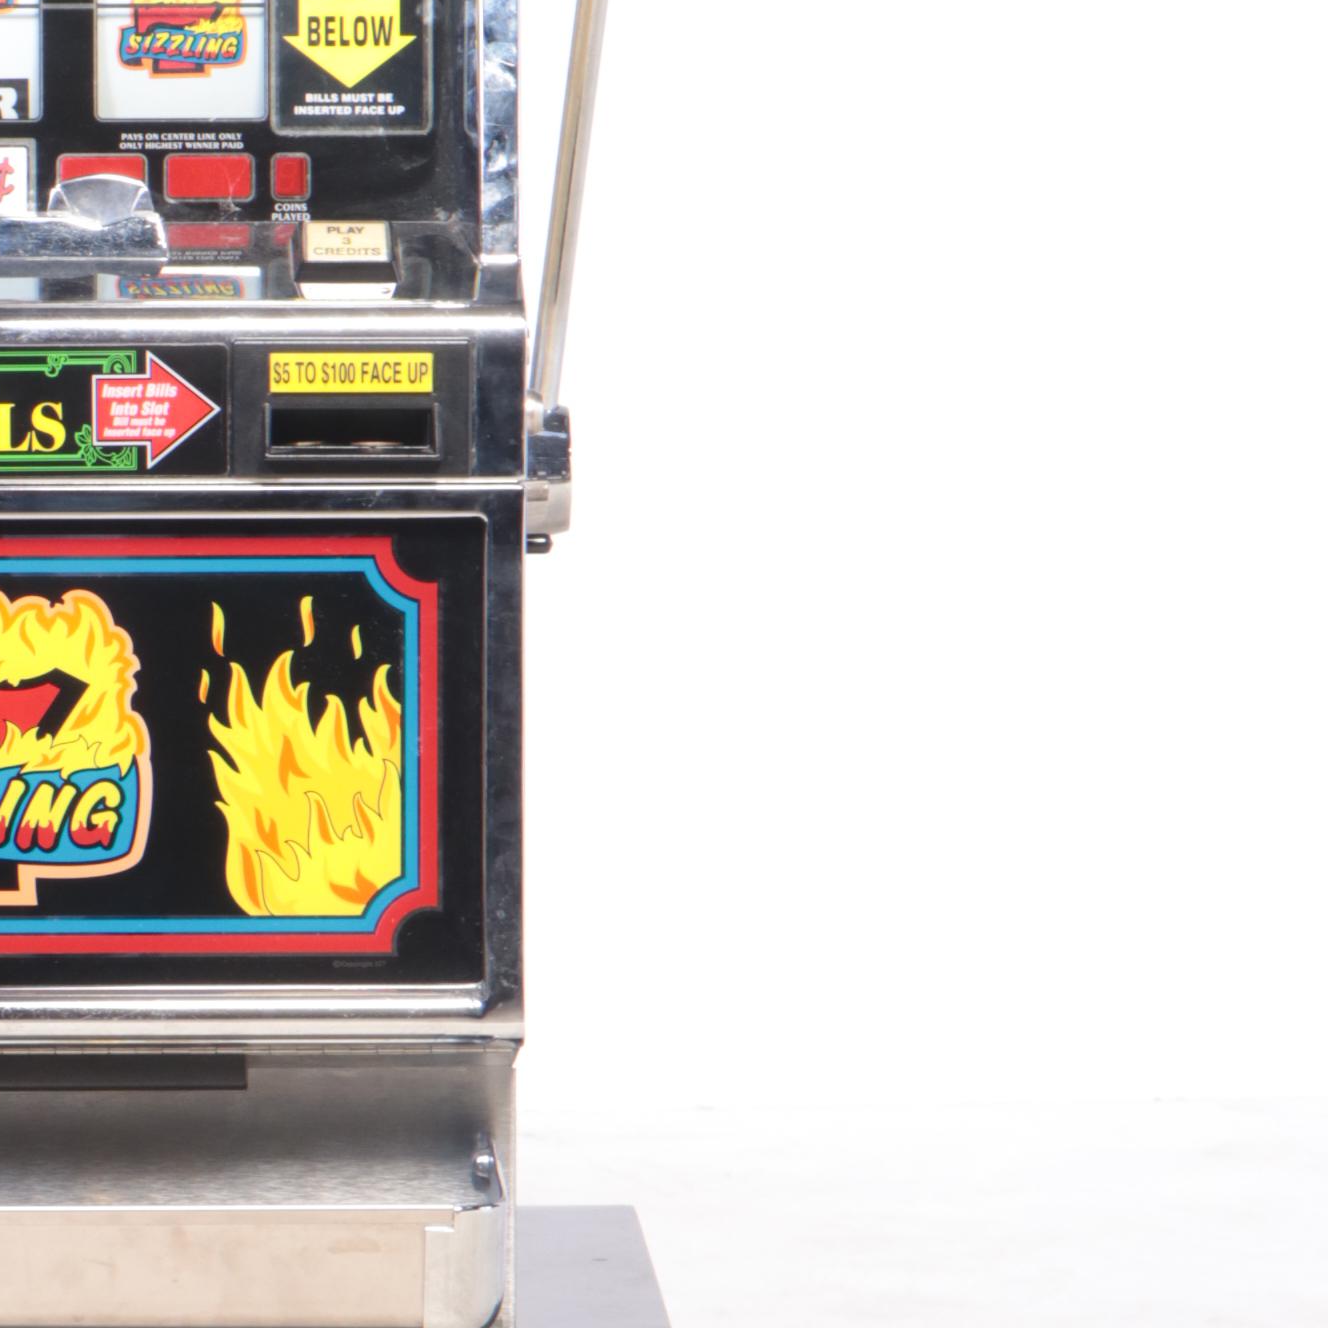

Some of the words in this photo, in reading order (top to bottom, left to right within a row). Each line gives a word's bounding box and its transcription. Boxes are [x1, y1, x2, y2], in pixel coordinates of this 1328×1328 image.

[307, 16, 393, 48] BELOW
[125, 31, 240, 60] SIZZLING
[305, 93, 339, 103] BILLS
[340, 93, 375, 103] MUST
[377, 93, 394, 103] BE
[293, 105, 352, 115] INSERTED
[354, 105, 386, 115] FACE
[387, 105, 405, 115] UP
[121, 133, 143, 141] PAYS
[145, 133, 159, 141] ON
[161, 133, 194, 141] CENTER
[197, 133, 216, 141] LINE
[218, 133, 242, 141] ONLY
[119, 142, 143, 150] ONLY
[145, 142, 183, 150] HIGHEST
[185, 142, 219, 150] WINNER
[221, 142, 244, 150] PAID
[274, 203, 308, 212] COINS
[272, 213, 311, 222] PLAYED
[327, 226, 364, 234] PLAY
[342, 237, 352, 245] 3
[313, 248, 382, 256] CREDITS
[295, 362, 316, 383] TO
[361, 362, 402, 383] FACE
[408, 362, 428, 383] UP
[102, 383, 143, 398] Insert
[145, 383, 178, 398] Bills
[110, 401, 138, 416] Into
[140, 401, 170, 416] Slot
